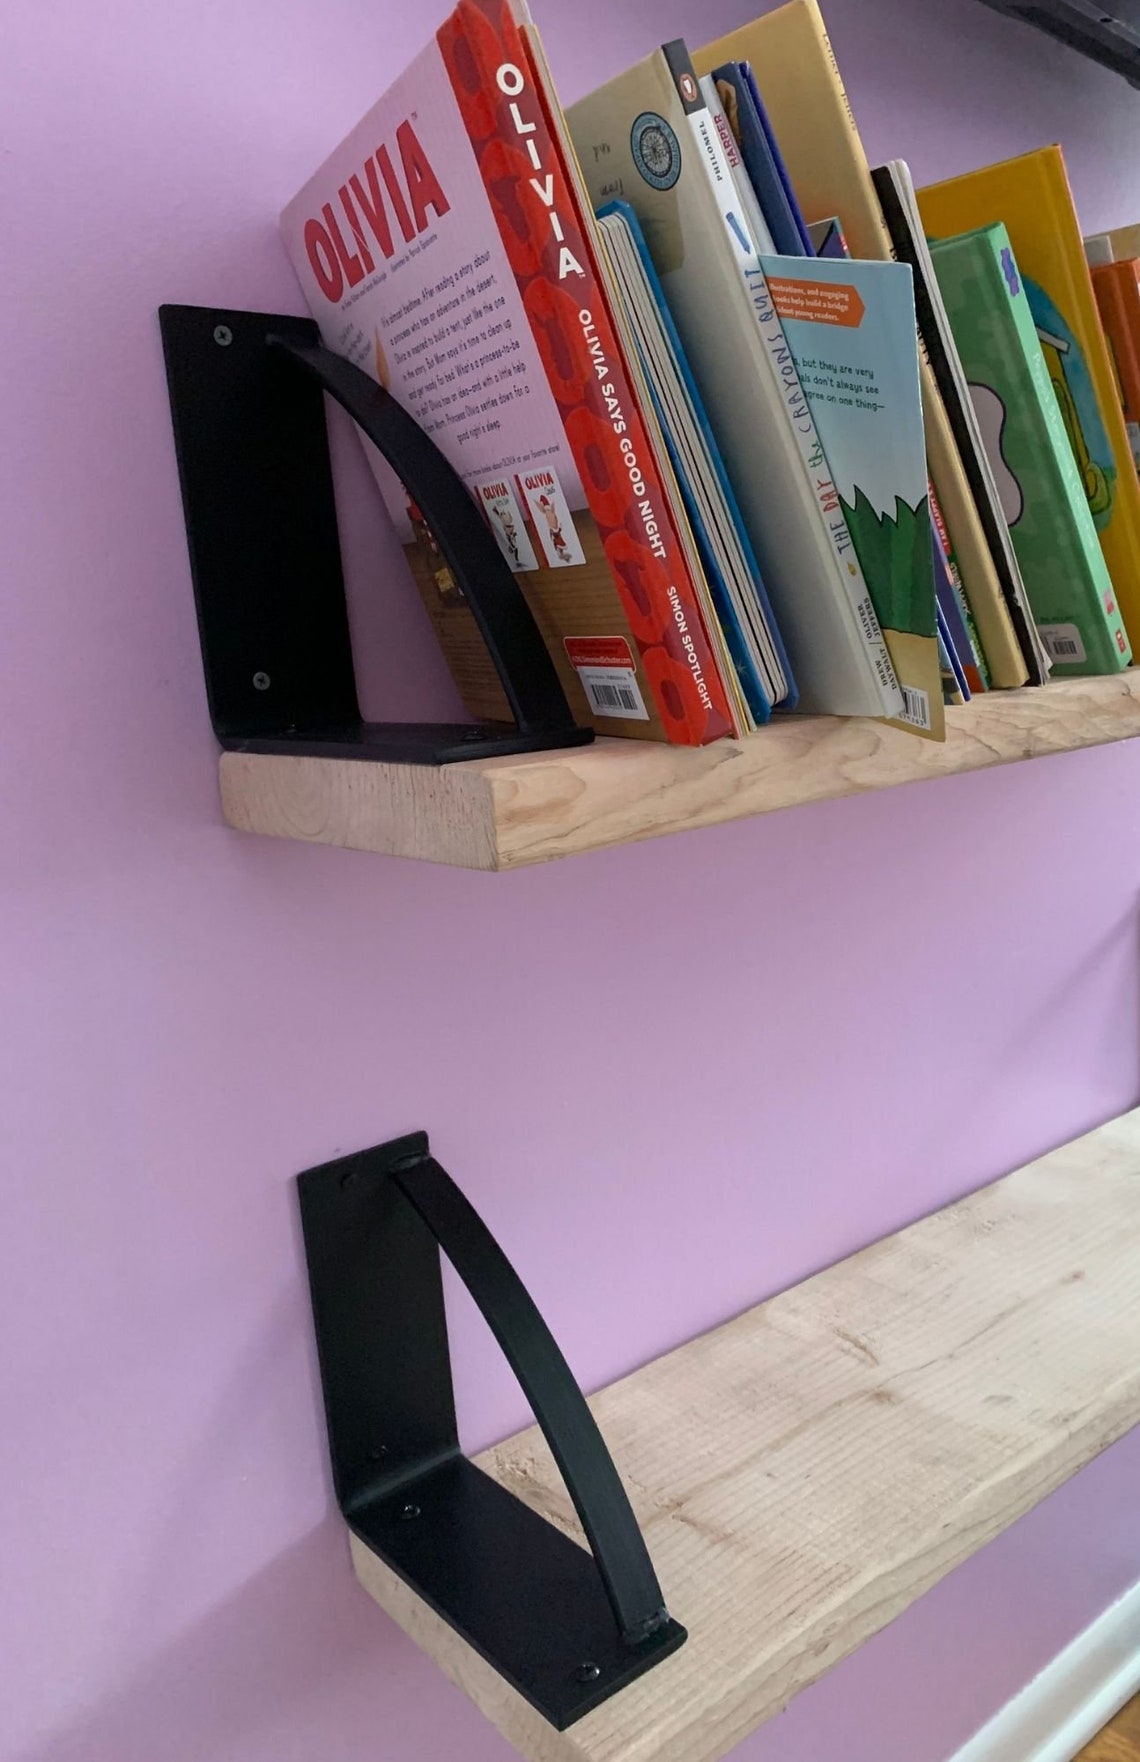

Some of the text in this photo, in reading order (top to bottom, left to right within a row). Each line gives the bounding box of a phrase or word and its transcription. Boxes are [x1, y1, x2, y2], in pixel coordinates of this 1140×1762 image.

[699, 121, 723, 181] PHILOMEL
[713, 112, 740, 168] HARPER
[496, 63, 584, 279] OLIVIA
[304, 119, 451, 303] OLIVIA
[744, 269, 774, 323] QUIT
[791, 296, 804, 307] help
[806, 298, 821, 307] build
[828, 301, 848, 313] bridge
[807, 287, 819, 296] and
[820, 289, 849, 302] engaging
[795, 309, 814, 319] young
[767, 334, 812, 433] CRAYONS
[803, 357, 816, 368] but
[818, 359, 838, 374] they
[839, 365, 853, 374] are
[855, 368, 874, 380] very
[813, 375, 834, 388] don't
[836, 380, 863, 394] always
[865, 386, 880, 395] see
[827, 394, 837, 402] on
[839, 396, 853, 406] one
[579, 309, 666, 559] OLIVIA SAYS GOOD NIGHT
[483, 482, 509, 500] OLIVIA
[525, 472, 554, 490] OLIVIA
[817, 479, 839, 513] DAY
[830, 520, 851, 554] THE
[857, 604, 873, 639] OLIVER
[864, 597, 881, 637] JEFFERS
[667, 586, 712, 710] SIMON SPOTLIGHT
[875, 660, 888, 687] DREW
[880, 648, 897, 690] DAYWALT
